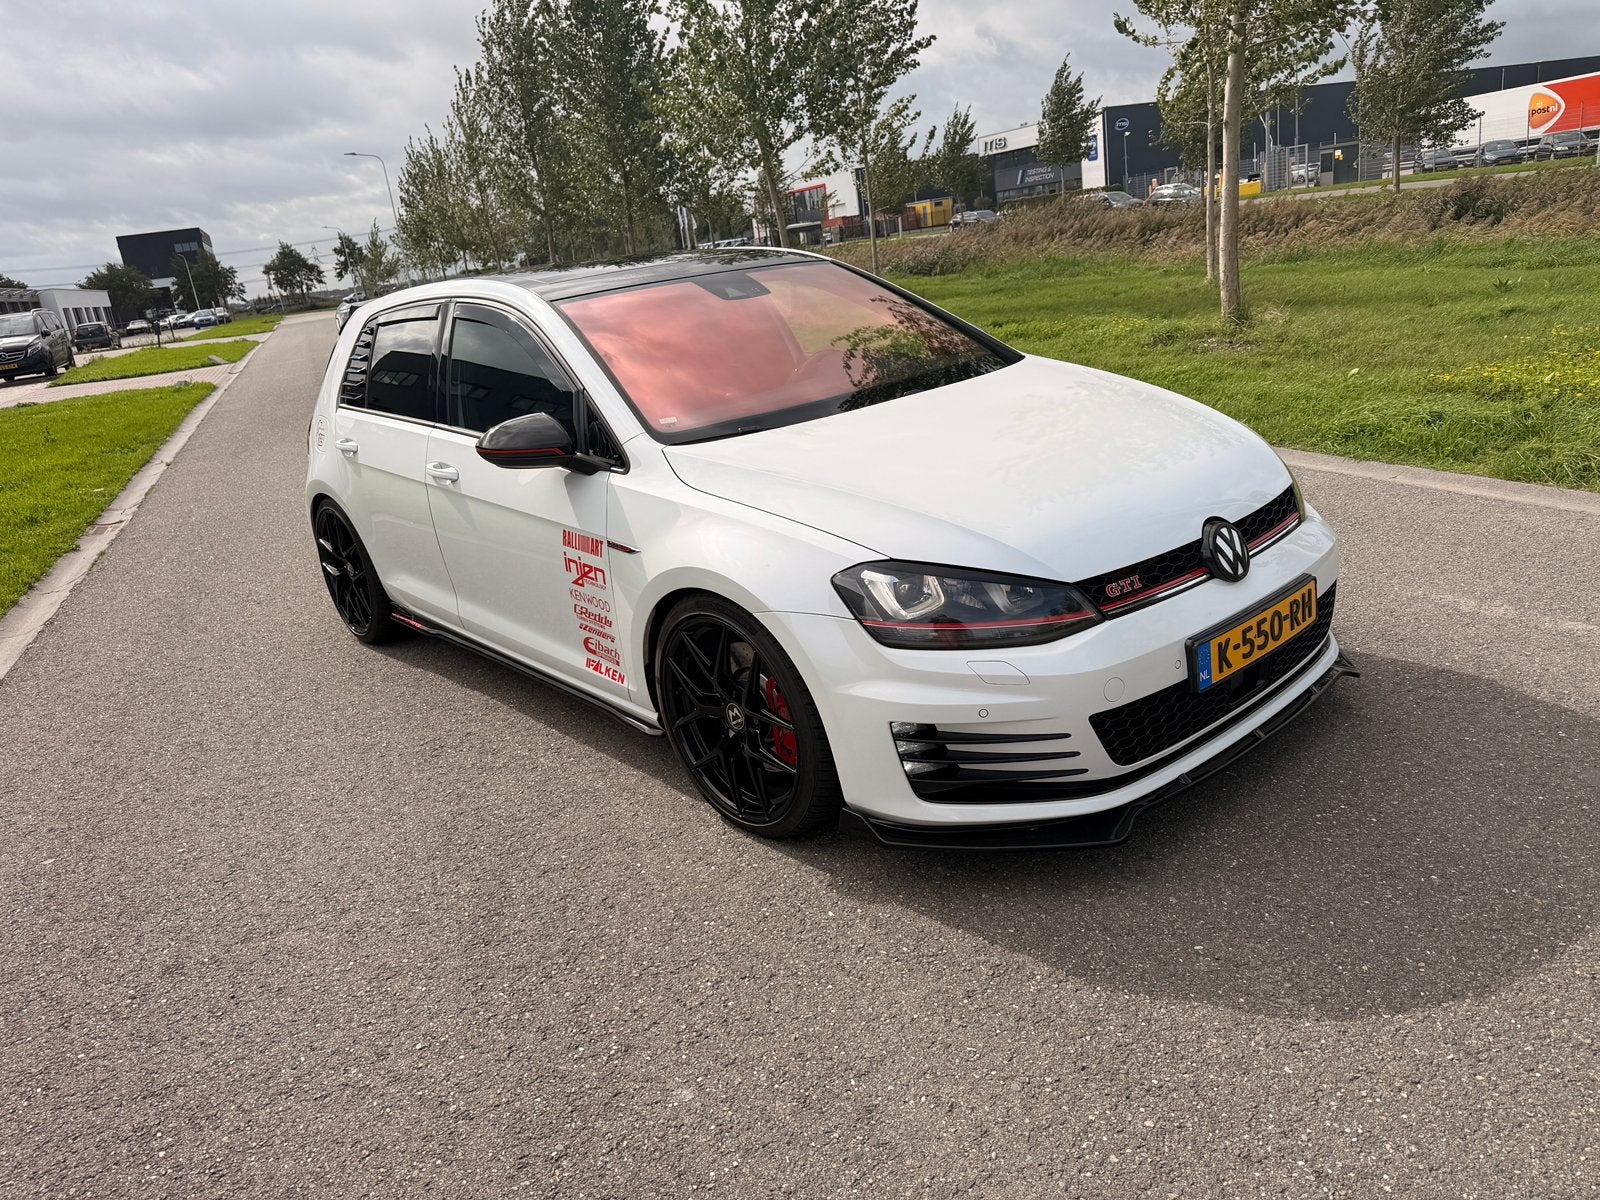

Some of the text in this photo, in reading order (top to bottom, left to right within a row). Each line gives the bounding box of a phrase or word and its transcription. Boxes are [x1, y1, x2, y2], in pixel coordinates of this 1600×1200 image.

[1025, 173, 1055, 182] INSPECTION
[1106, 575, 1142, 598] GTI
[569, 588, 610, 612] KENWOOD
[1217, 588, 1312, 674] K-550-RH
[583, 637, 620, 660] Eibach
[586, 657, 625, 684] FALKEN
[1200, 669, 1210, 681] NL
